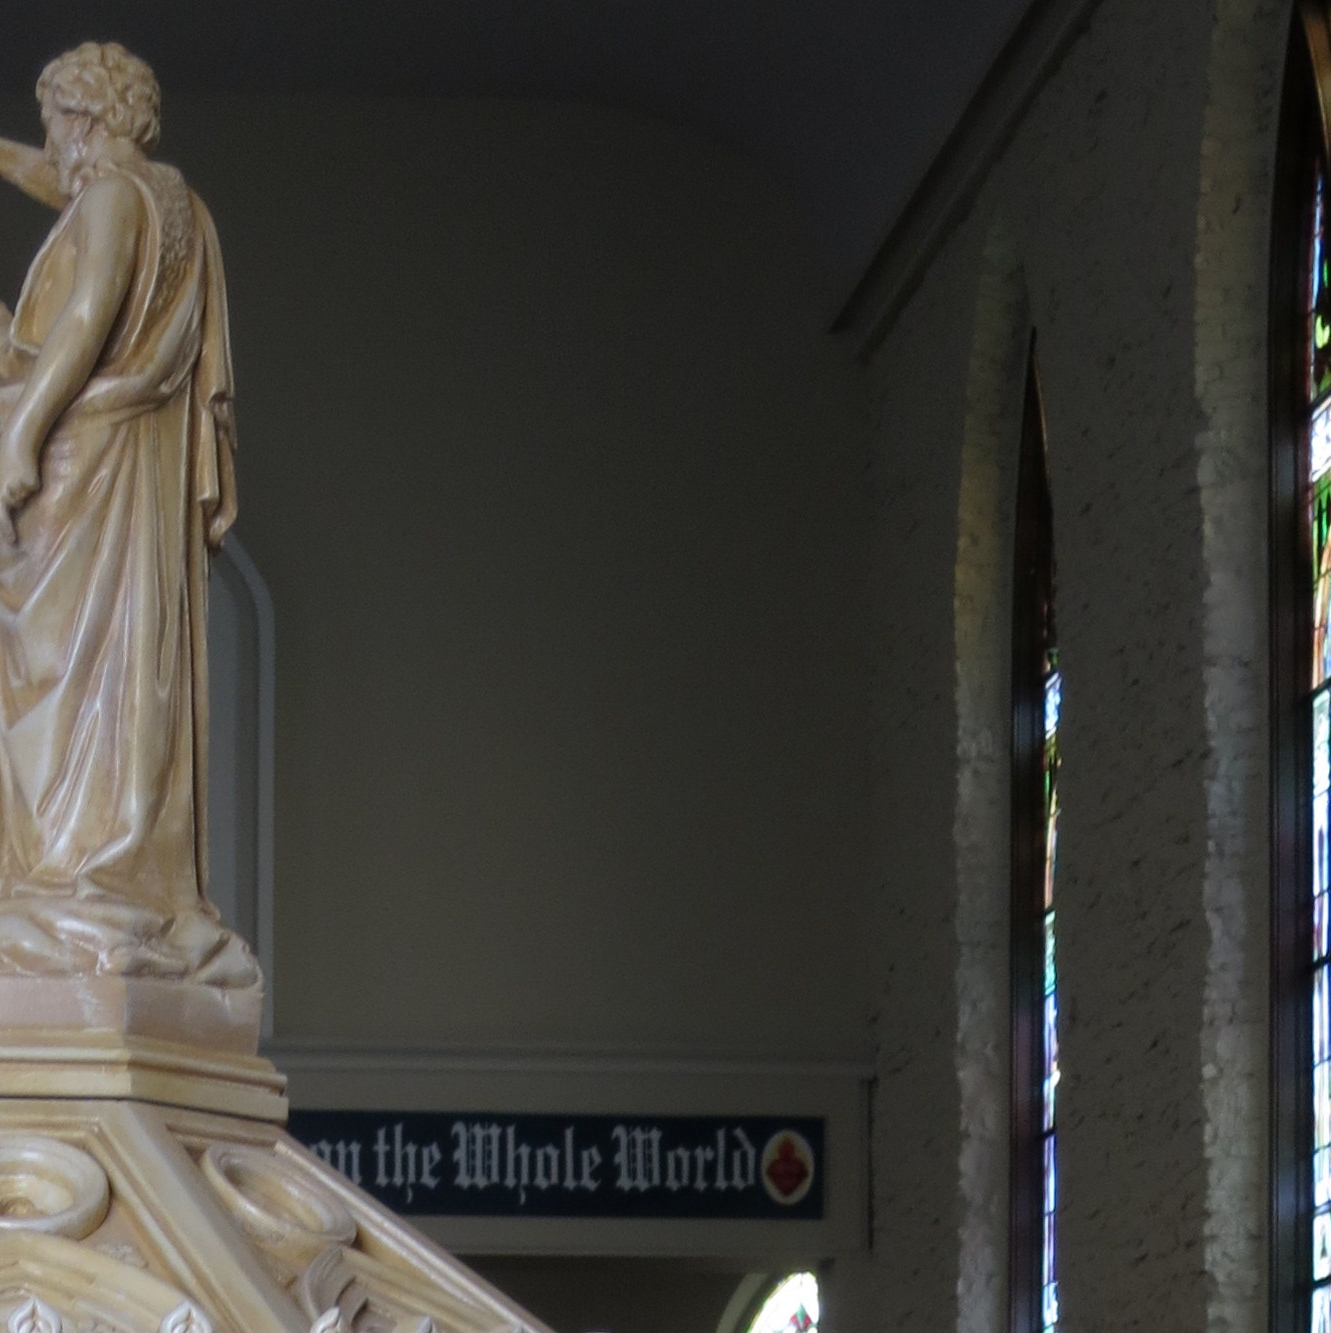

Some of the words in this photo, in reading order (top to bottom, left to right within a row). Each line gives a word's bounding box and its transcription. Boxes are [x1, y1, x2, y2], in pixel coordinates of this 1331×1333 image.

[373, 1122, 442, 1205] the
[451, 1121, 601, 1206] Whole
[612, 1125, 756, 1192] World
